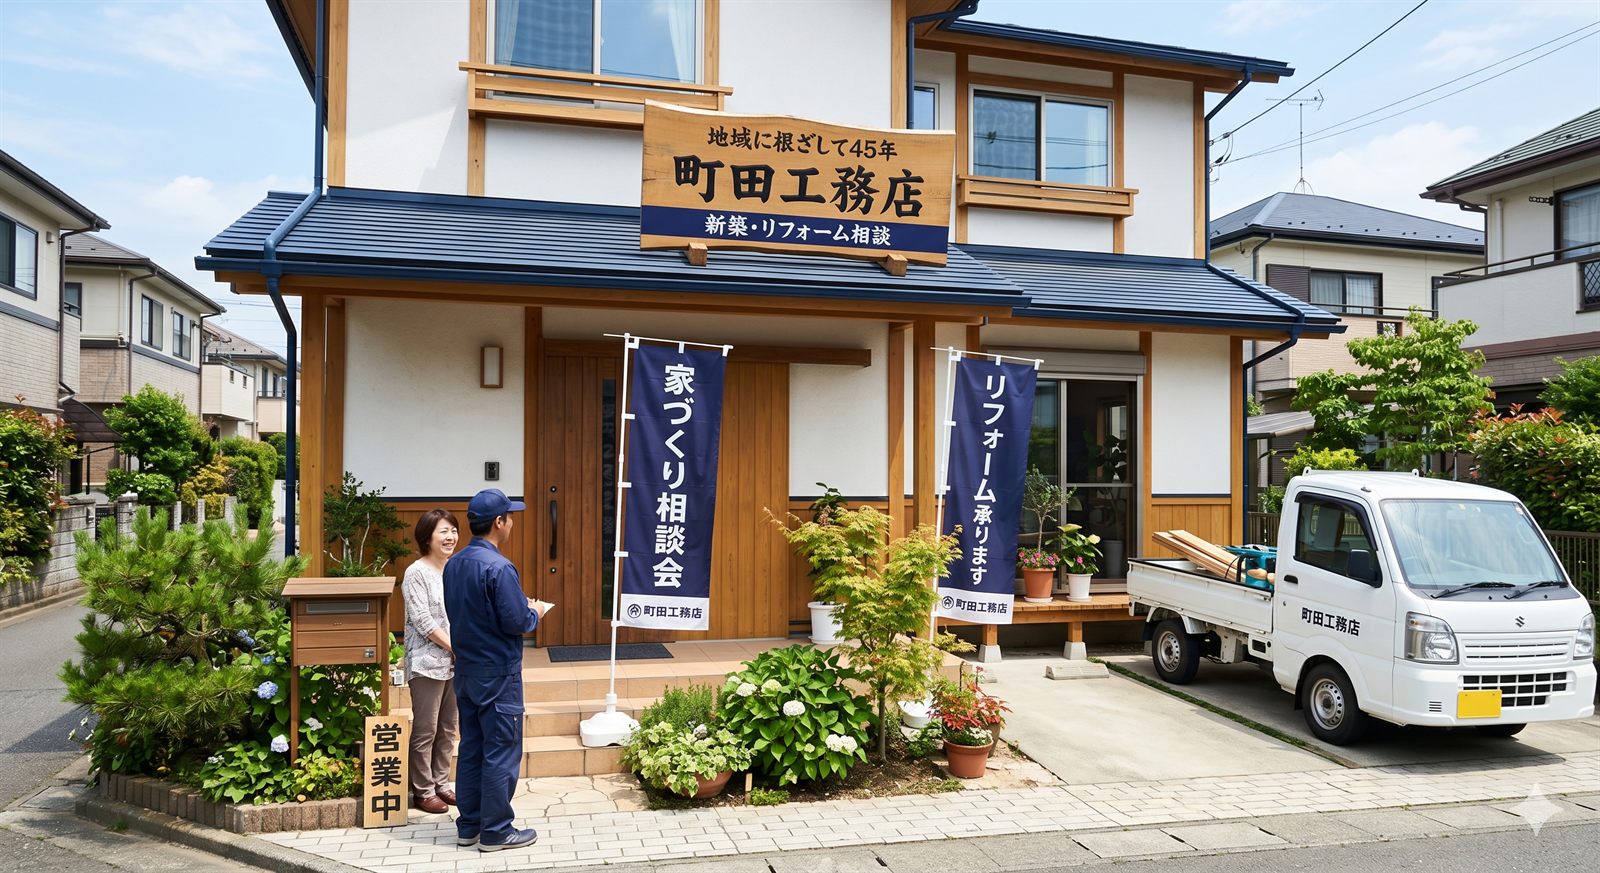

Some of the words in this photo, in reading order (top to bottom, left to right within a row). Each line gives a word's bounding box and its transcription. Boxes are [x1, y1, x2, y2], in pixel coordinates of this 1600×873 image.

[707, 126, 898, 162] 地域に根ざして45年
[673, 154, 926, 218] 町田工務店
[704, 213, 891, 246] 新築・リフォーム相談
[652, 364, 695, 588] 家づくり相談会
[970, 375, 1006, 585] リフォーム承ります
[643, 605, 703, 619] 町田工務店
[956, 598, 1007, 614] 町田工務店
[1302, 607, 1360, 636] 町田工務店
[371, 723, 402, 820] 営業中
